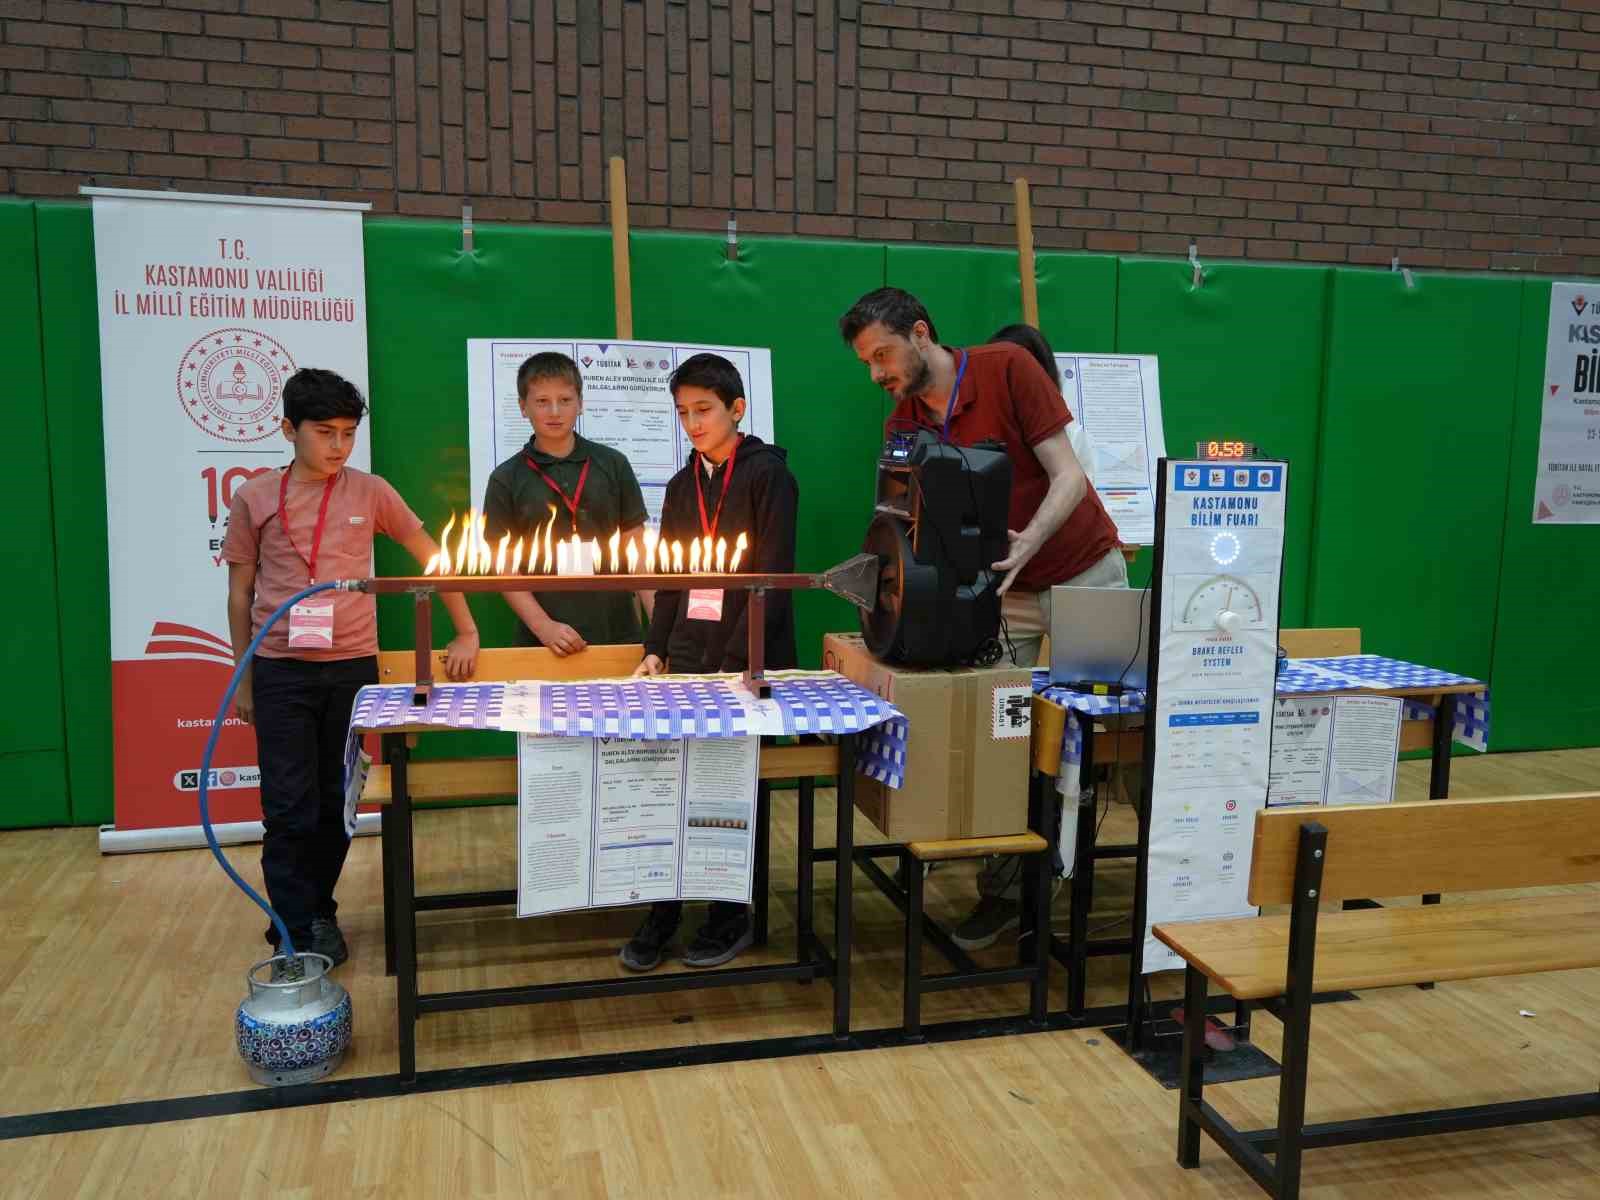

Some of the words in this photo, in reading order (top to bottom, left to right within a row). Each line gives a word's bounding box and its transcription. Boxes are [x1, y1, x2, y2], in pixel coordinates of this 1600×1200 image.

[218, 239, 250, 261] T.C.
[145, 264, 249, 290] KASTAMONU
[255, 267, 324, 293] VALİLİĞİ
[114, 289, 130, 316] İL
[189, 293, 246, 319] EĞİTİM
[253, 296, 355, 322] MÜDÜRLÜĞÜ
[1207, 441, 1245, 457] 0.58
[1193, 496, 1258, 510] KASTAMONU
[1191, 511, 1223, 527] BİLİM
[1226, 513, 1259, 527] FUARI
[1192, 646, 1216, 656] BRAKE
[1203, 657, 1232, 667] SYSTEM
